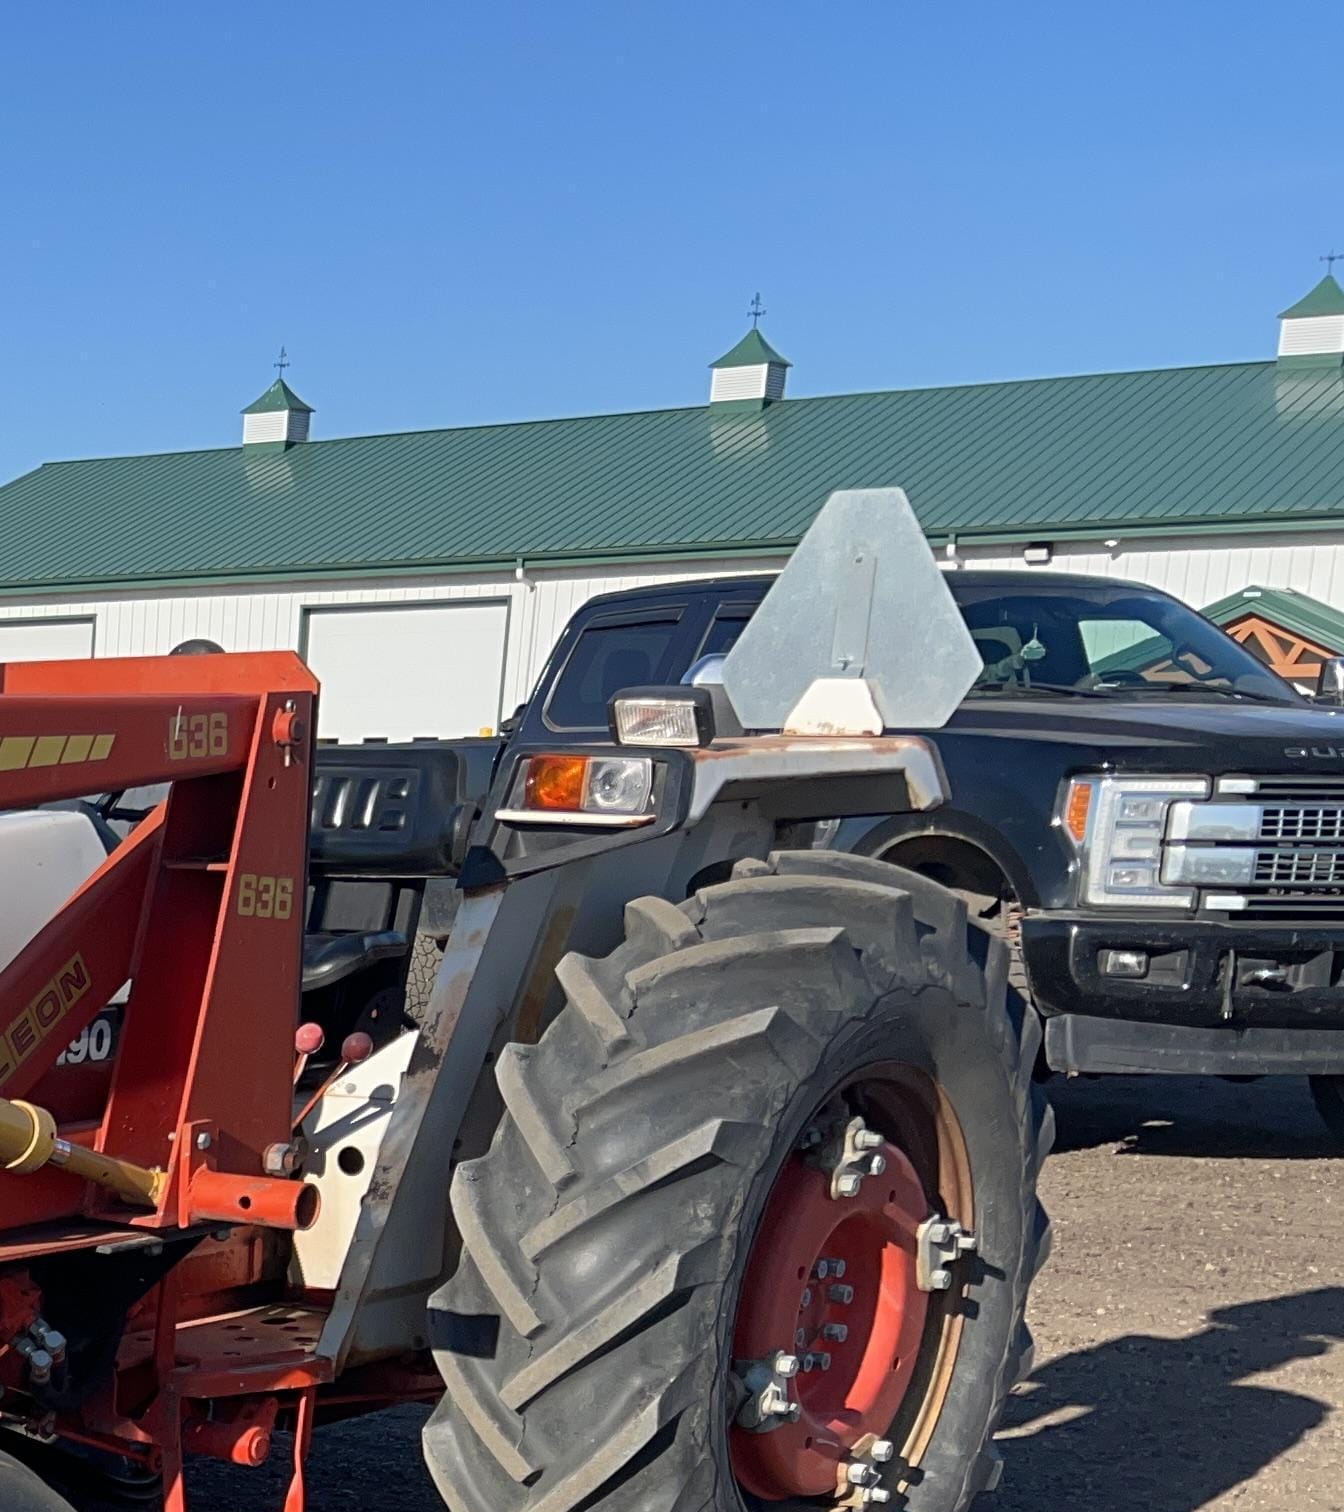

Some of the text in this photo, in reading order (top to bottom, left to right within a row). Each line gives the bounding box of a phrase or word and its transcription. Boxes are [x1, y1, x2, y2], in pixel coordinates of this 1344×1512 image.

[169, 712, 228, 760] 636
[237, 873, 294, 920] 636
[56, 1018, 112, 1066] 90
